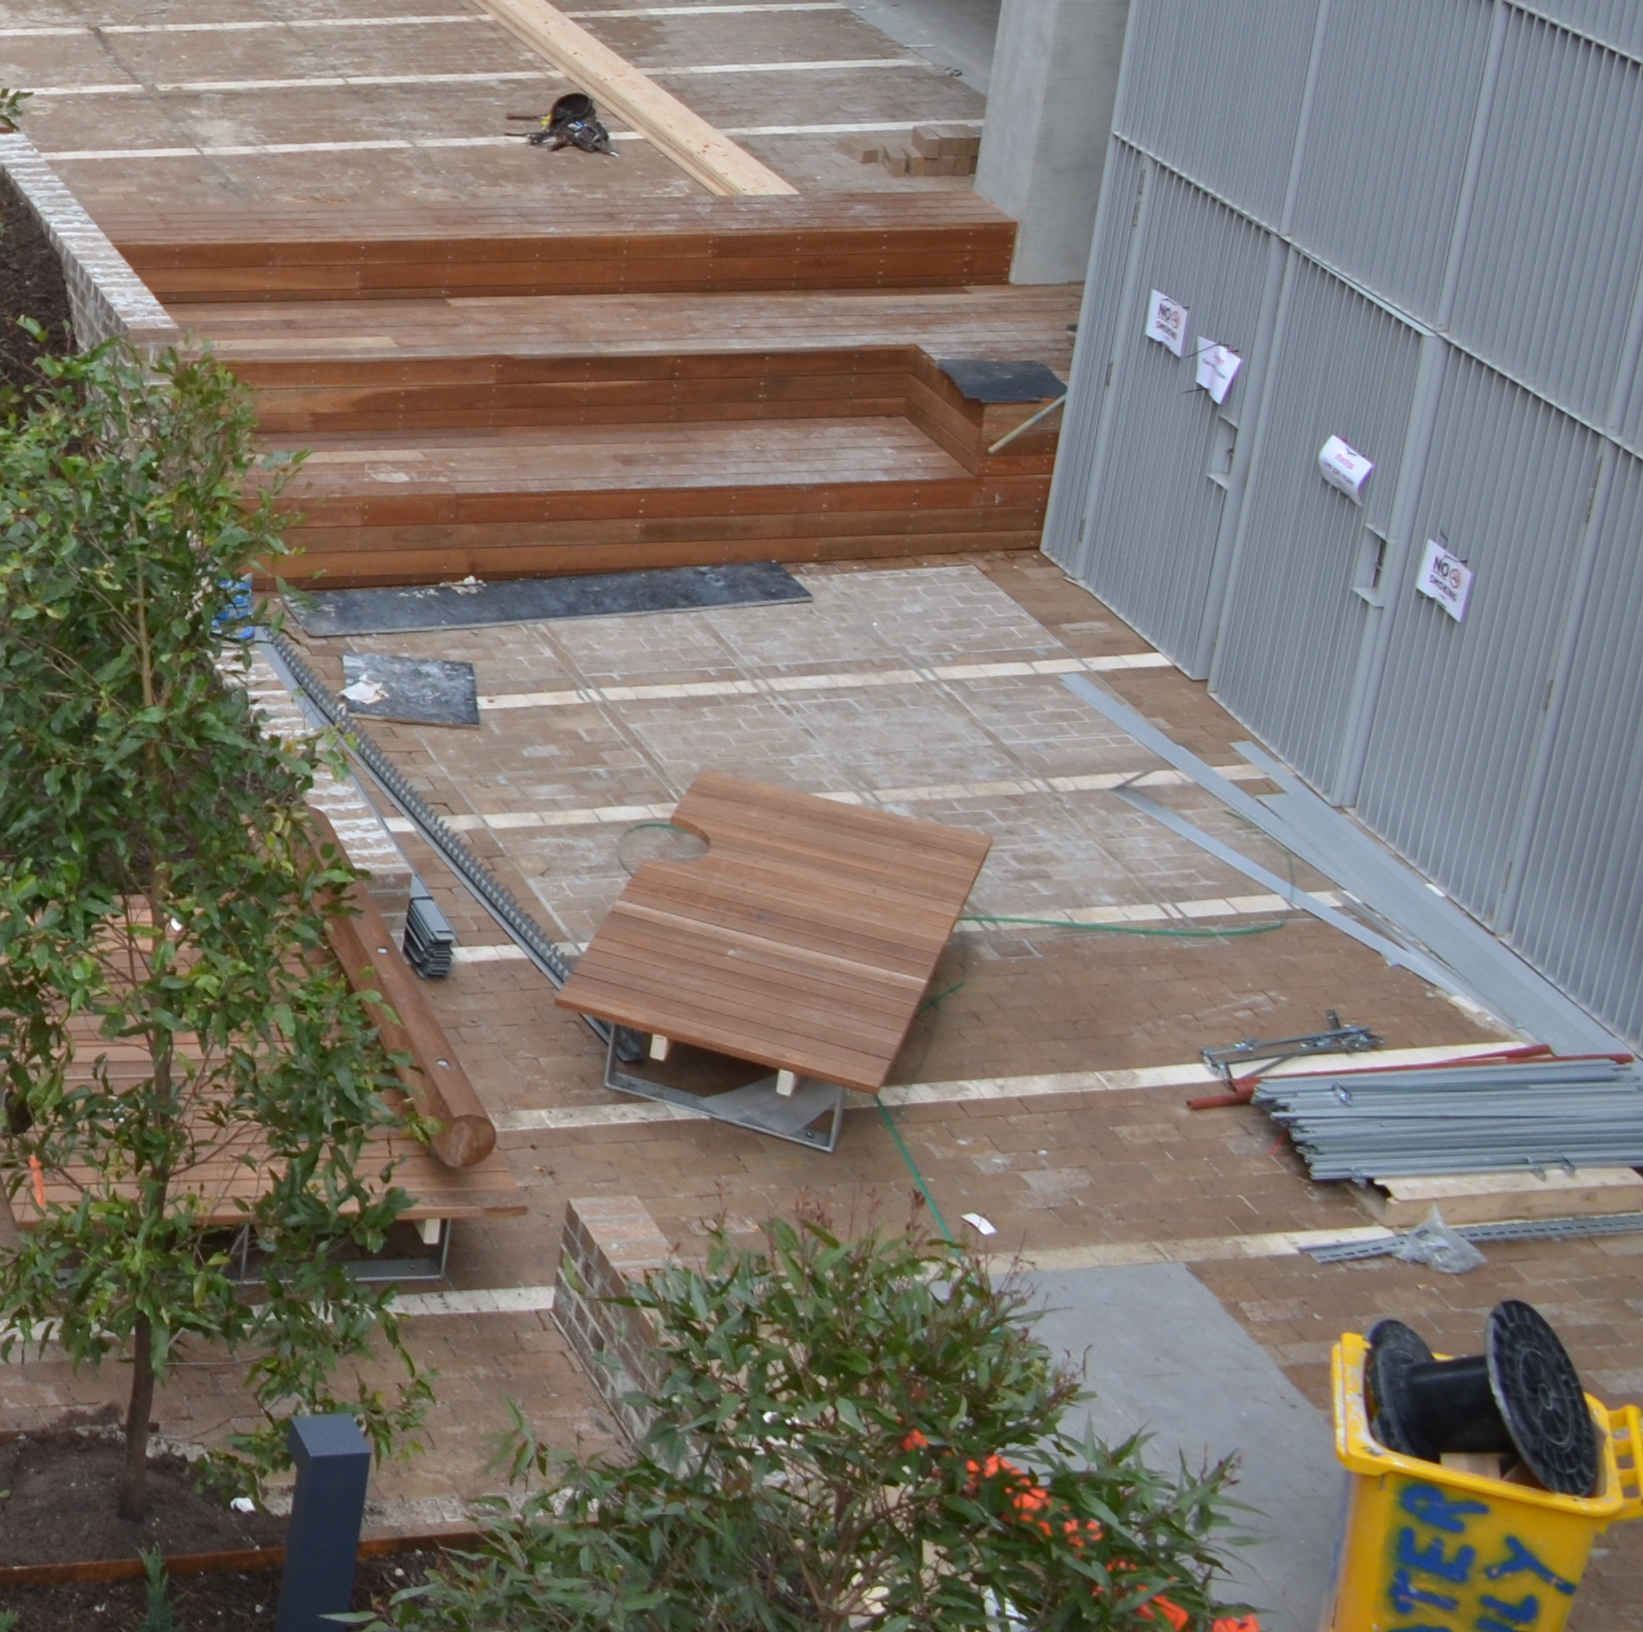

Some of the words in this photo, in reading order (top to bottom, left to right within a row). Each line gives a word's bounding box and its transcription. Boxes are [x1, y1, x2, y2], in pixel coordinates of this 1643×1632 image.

[1429, 574, 1457, 603] SMOKING
[1433, 555, 1450, 578] NO
[1389, 1483, 1490, 1631] TER
[1475, 1535, 1577, 1631] LY
